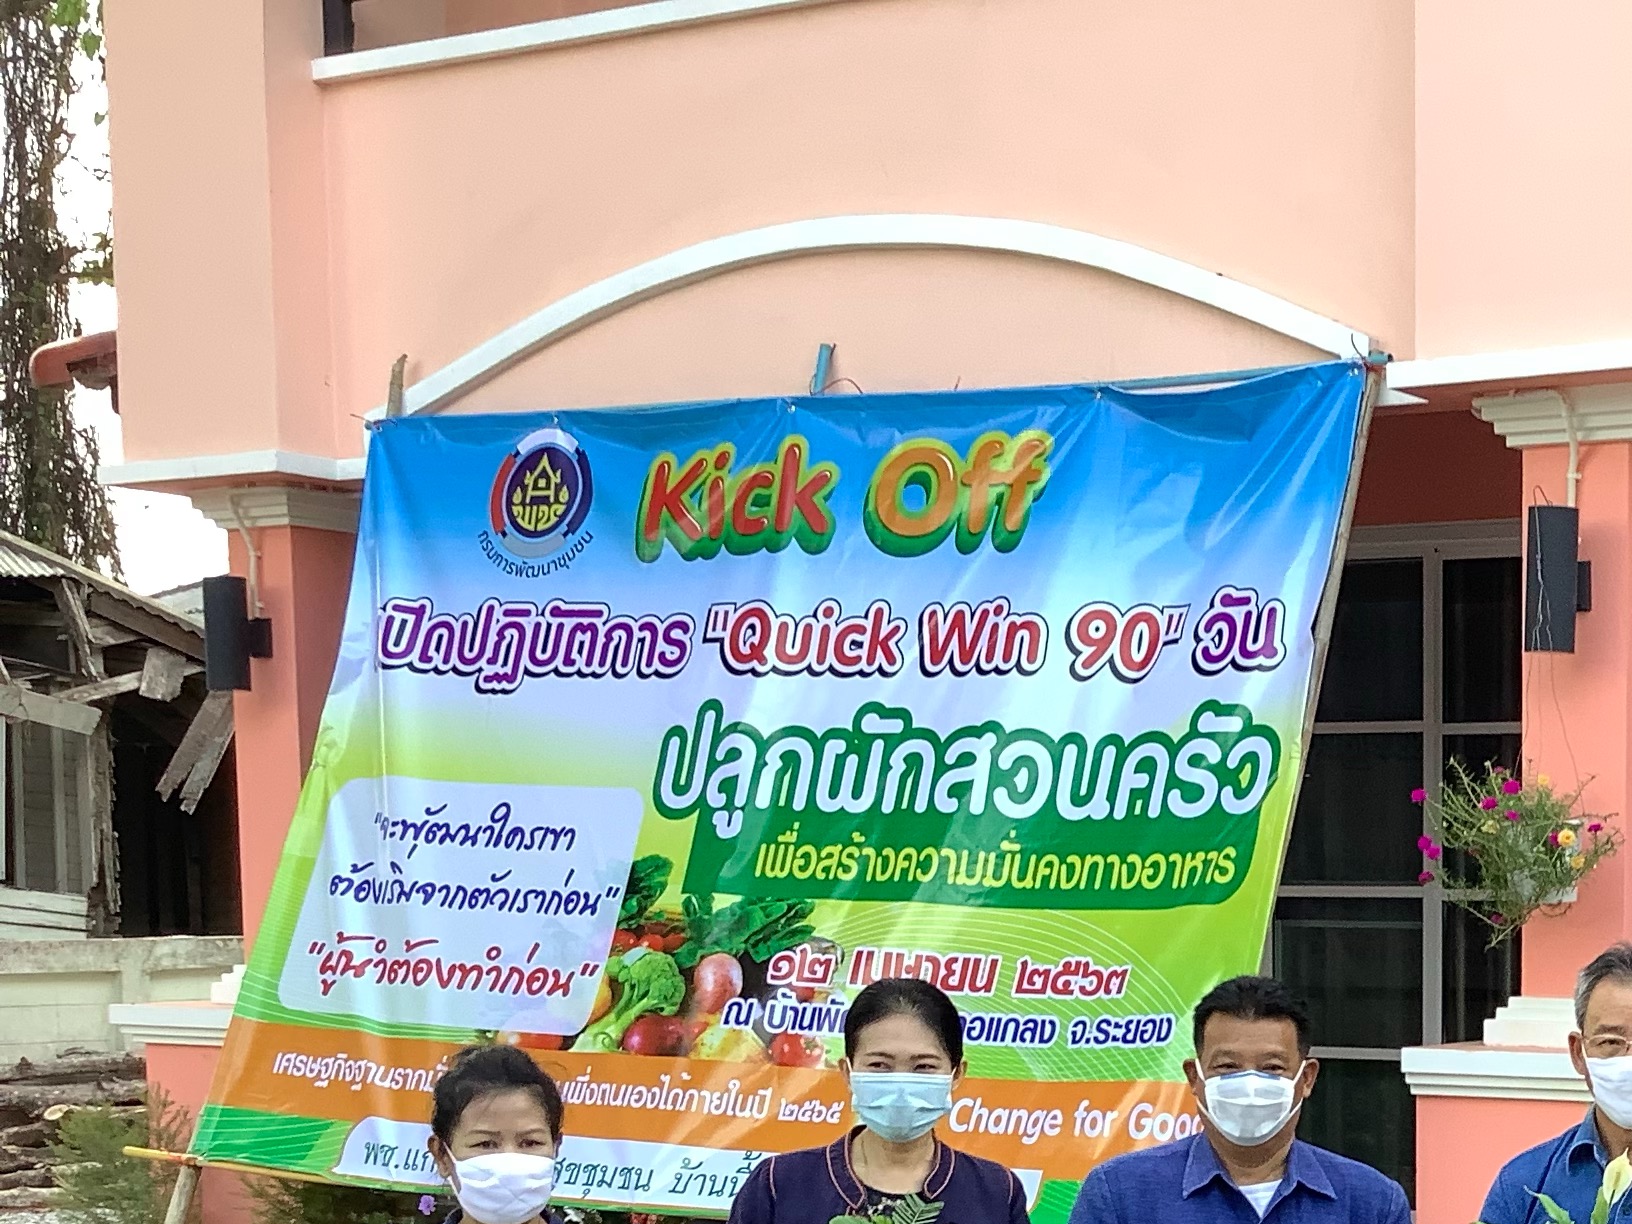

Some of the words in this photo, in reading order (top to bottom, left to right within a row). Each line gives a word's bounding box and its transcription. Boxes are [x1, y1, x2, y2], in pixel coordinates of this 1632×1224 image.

[637, 436, 838, 562] Kick
[864, 430, 1054, 556] Off
[477, 529, 594, 579] กรมการพัฒนาชุมชน
[920, 598, 1048, 676] Win
[1192, 585, 1285, 672] วัน
[654, 699, 1280, 838] ปลูกผักสวนครัว
[754, 822, 1237, 892] เพื่อสร้างความมั่นคงทางอาหาร
[767, 949, 833, 986] ๑๒
[1013, 958, 1132, 999] ๒๕๖๓
[722, 999, 755, 1028] ณ
[1069, 1014, 1175, 1048] จ.ระยอง
[777, 1098, 845, 1124] ๒๕๖๕
[949, 1097, 1063, 1144] Change
[1073, 1099, 1118, 1138] for
